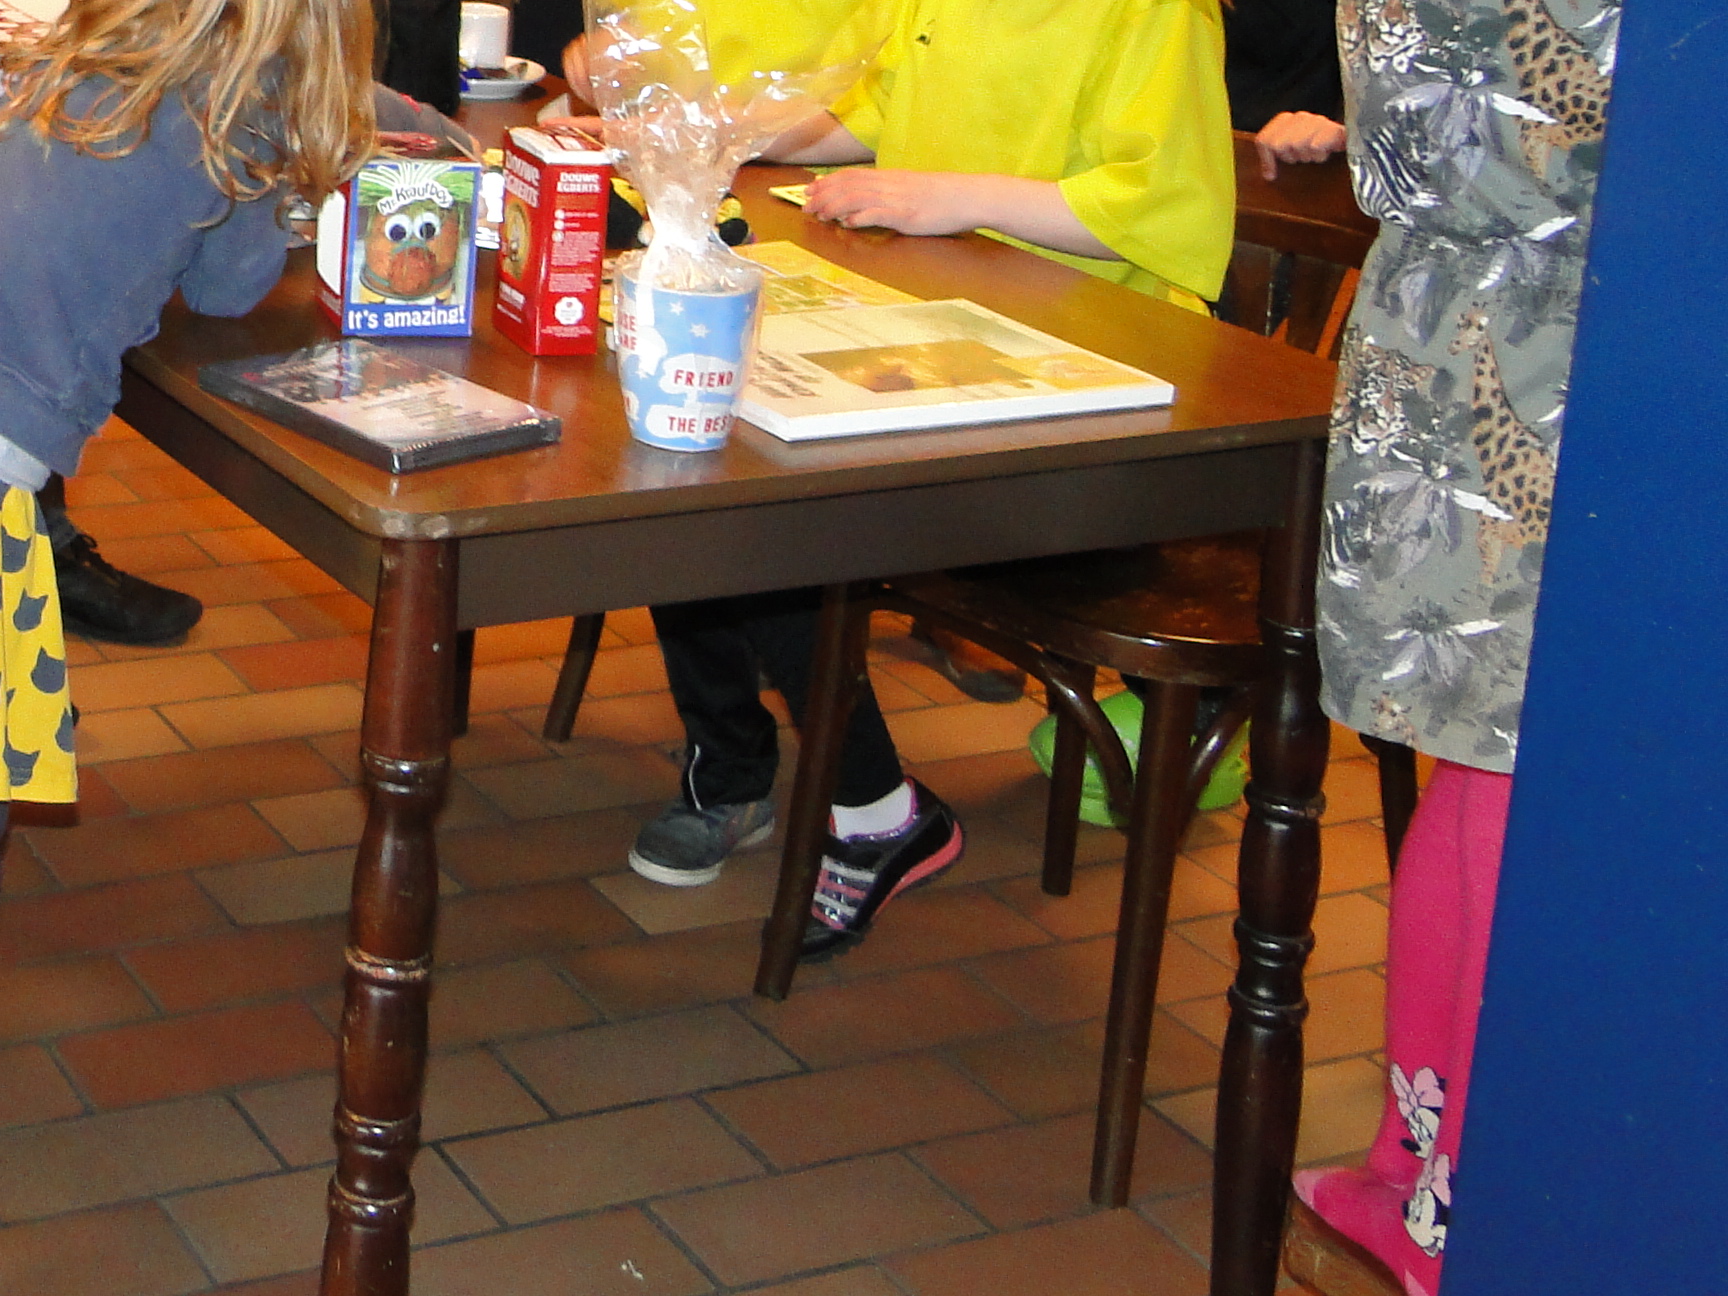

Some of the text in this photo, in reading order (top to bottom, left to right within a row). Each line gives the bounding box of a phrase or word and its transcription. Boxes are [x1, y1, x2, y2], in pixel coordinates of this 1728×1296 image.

[348, 304, 466, 330] It's amazing!
[674, 368, 733, 388] FRIEND
[668, 415, 697, 434] THE
